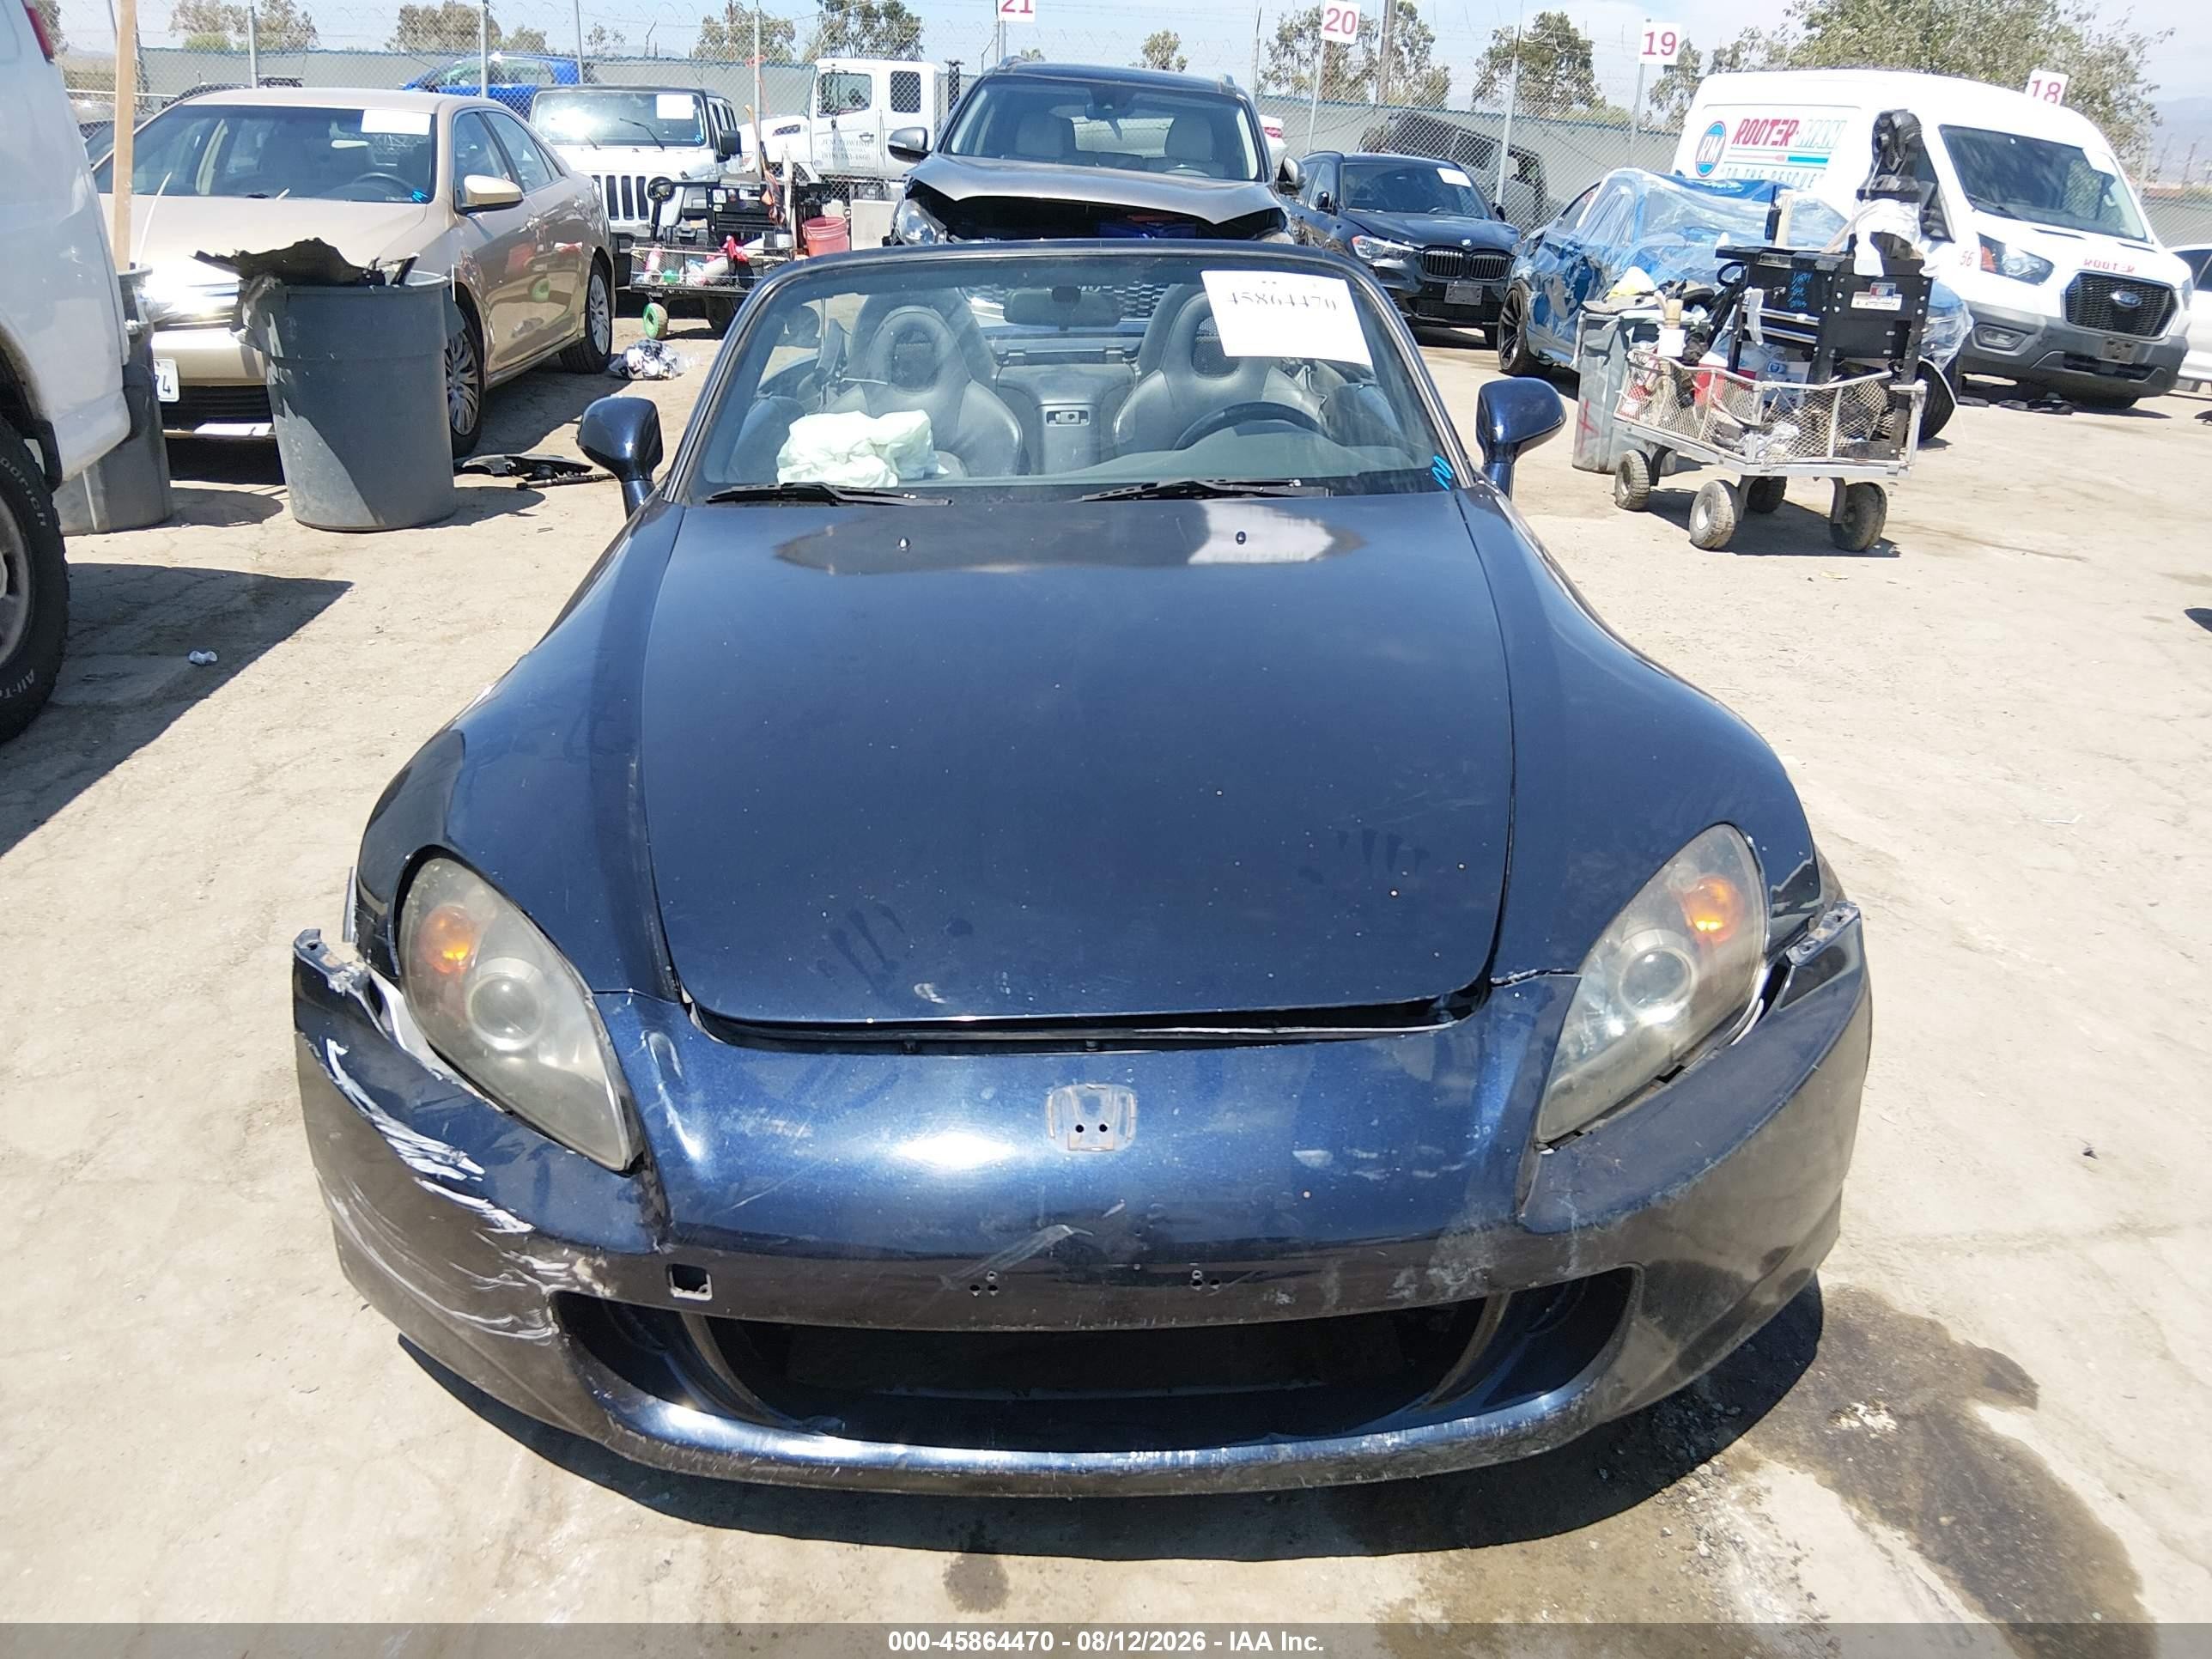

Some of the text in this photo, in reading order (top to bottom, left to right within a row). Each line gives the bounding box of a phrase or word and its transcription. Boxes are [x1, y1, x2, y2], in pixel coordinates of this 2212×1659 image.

[1324, 8, 1357, 34] 20
[1642, 31, 1677, 56] 19
[2032, 79, 2062, 104] 18
[1960, 252, 1975, 267] 56
